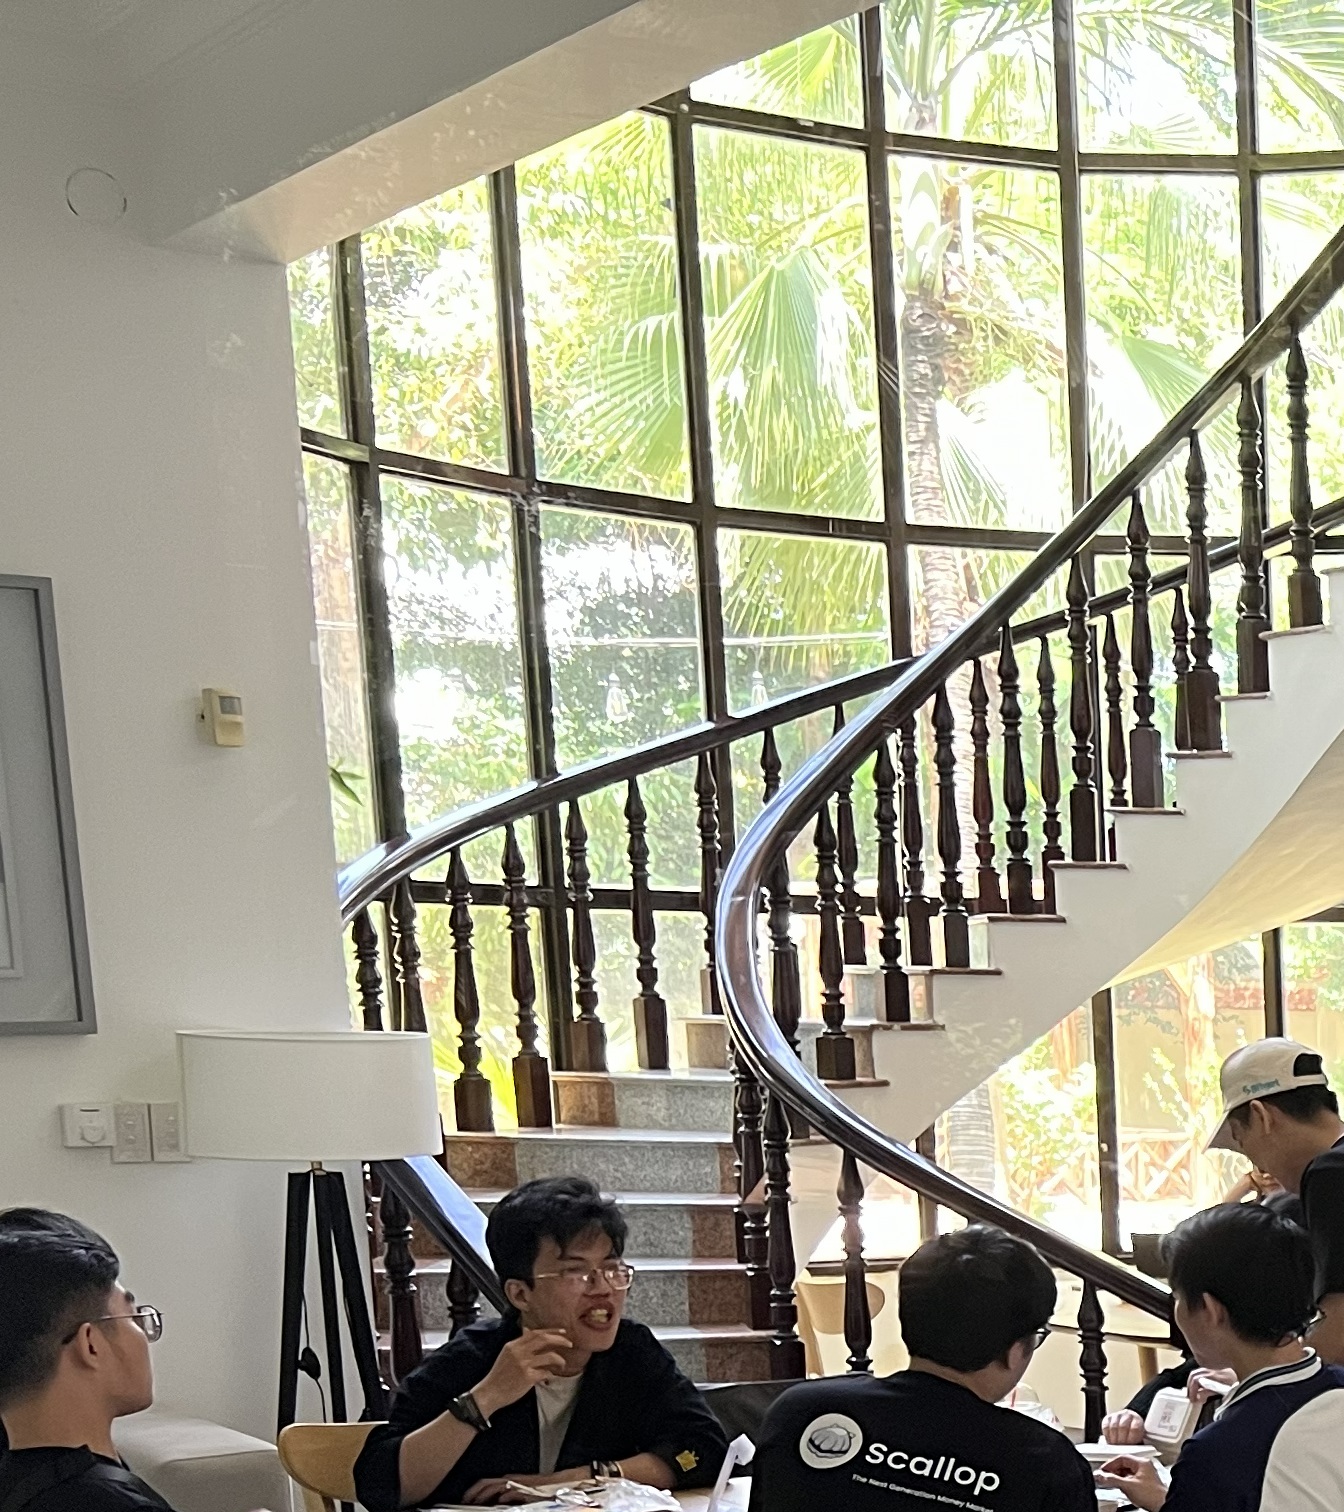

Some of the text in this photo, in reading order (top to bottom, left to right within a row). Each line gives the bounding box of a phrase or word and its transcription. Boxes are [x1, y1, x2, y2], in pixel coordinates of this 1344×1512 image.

[852, 1474, 867, 1483] The
[889, 1483, 936, 1500] Generation
[937, 1495, 965, 1508] Money
[865, 1443, 1000, 1496] scallop
